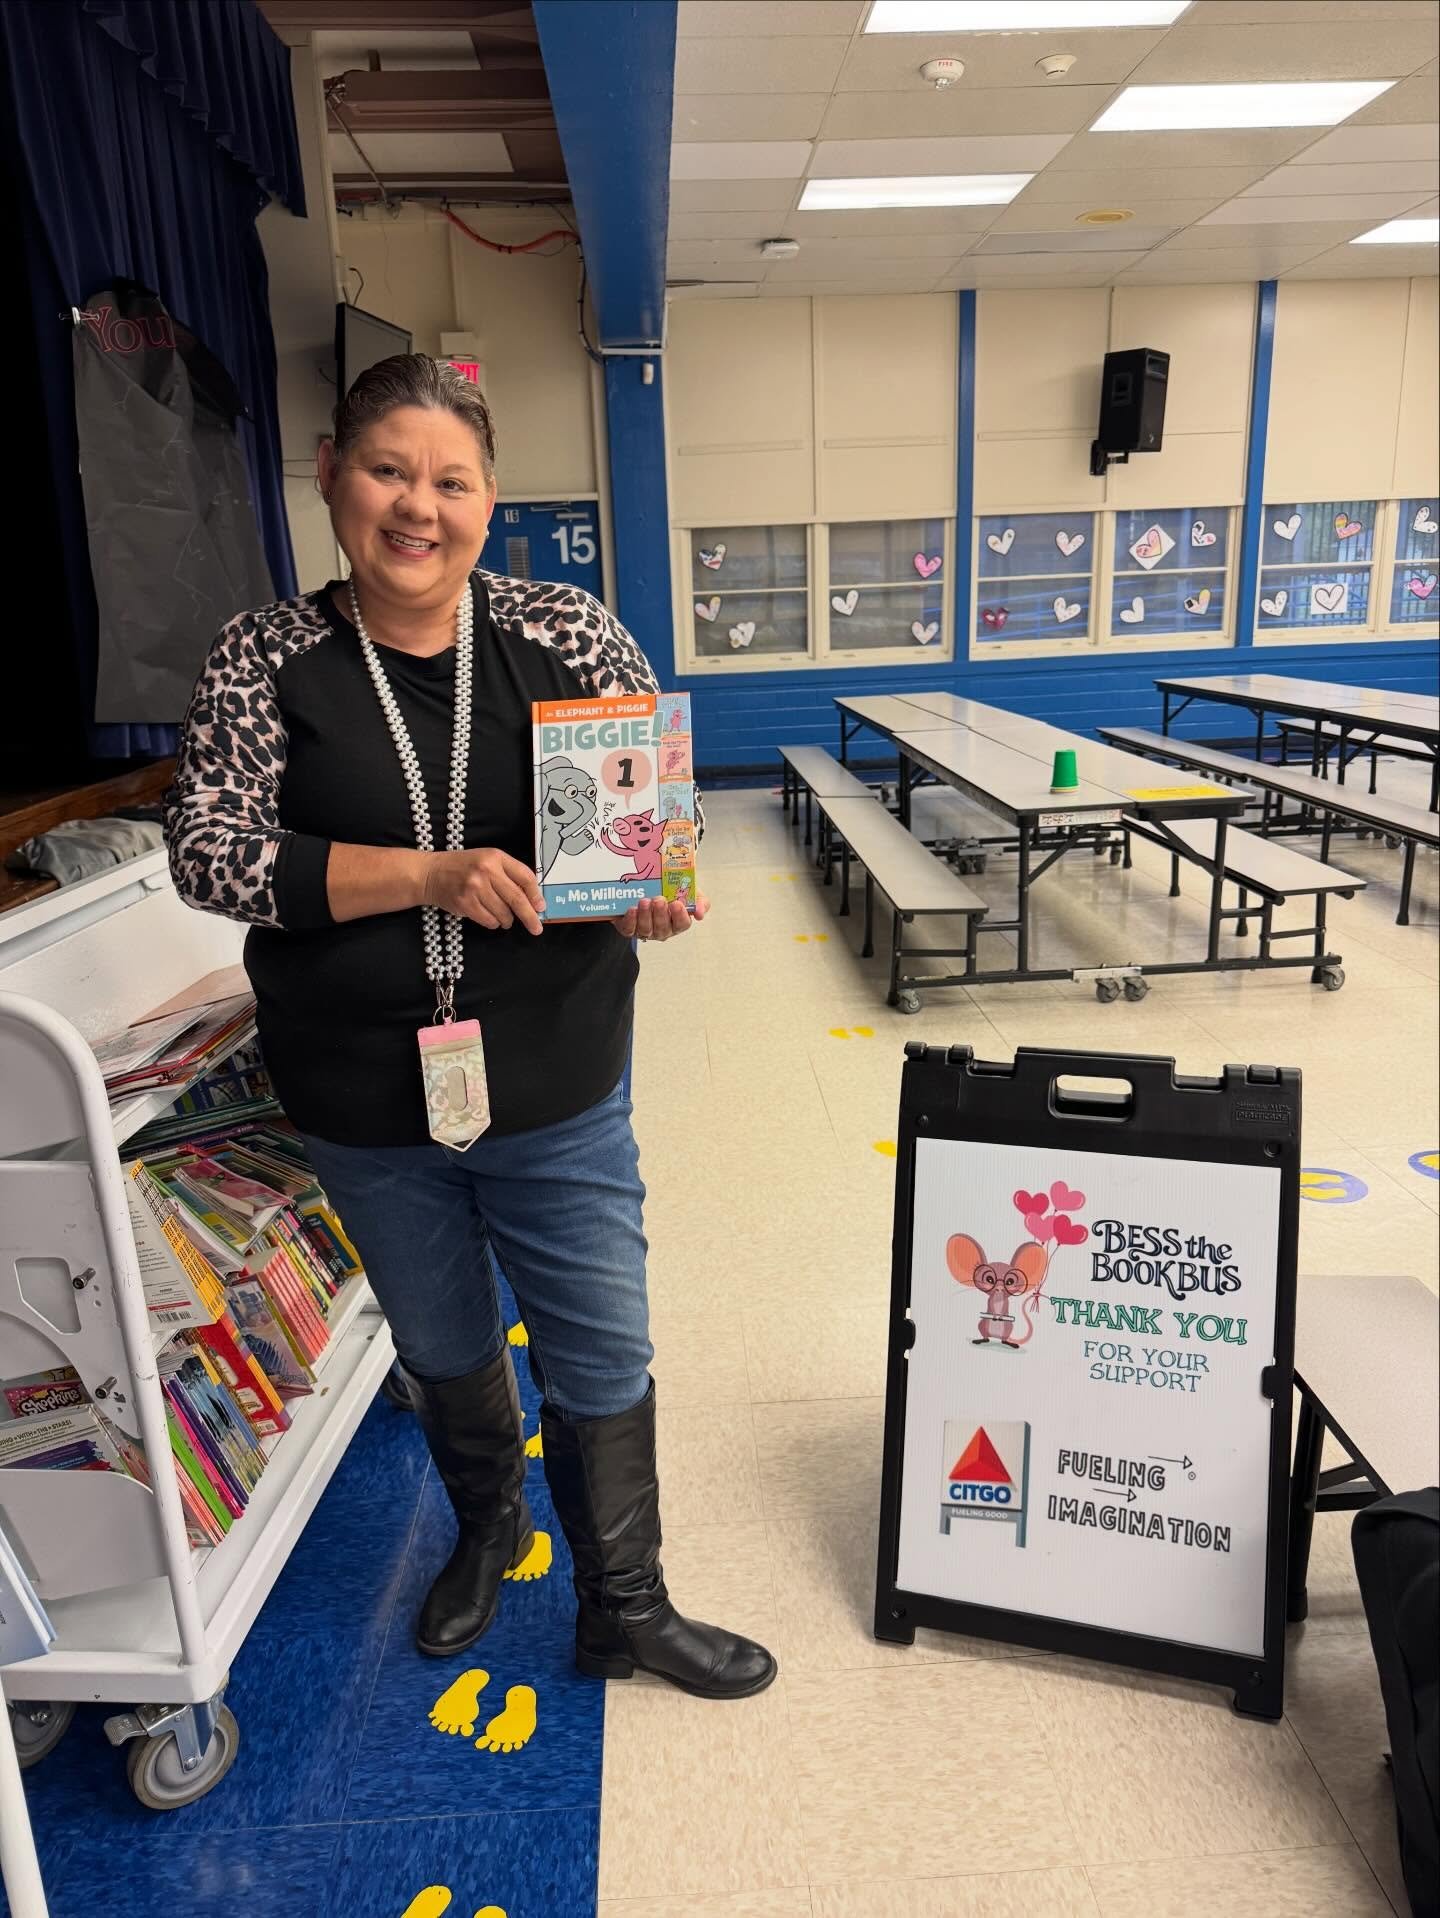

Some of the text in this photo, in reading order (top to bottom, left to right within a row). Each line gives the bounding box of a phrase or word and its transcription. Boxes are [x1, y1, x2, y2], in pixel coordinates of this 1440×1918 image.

[85, 305, 176, 353] You
[551, 525, 596, 565] 15
[555, 707, 604, 718] ELEPHANT
[607, 706, 614, 714] &
[616, 703, 649, 714] PIGGIE
[543, 711, 664, 754] BIGGIE!
[616, 758, 635, 788] 1
[555, 886, 645, 905] By Mo Willems
[580, 902, 617, 912] Volume 1
[1092, 1219, 1233, 1265] BESS the
[1051, 1297, 1248, 1345] THANK YOU
[1084, 1340, 1210, 1373] FOR YOUR
[1090, 1363, 1202, 1392] SUPPORT
[21, 1389, 80, 1415] Shopkins
[1058, 1449, 1165, 1491] FUELING
[949, 1483, 1012, 1504] CITGO
[951, 1508, 1008, 1519] FUELING GOOD
[1048, 1495, 1231, 1552] IMAGINATION
